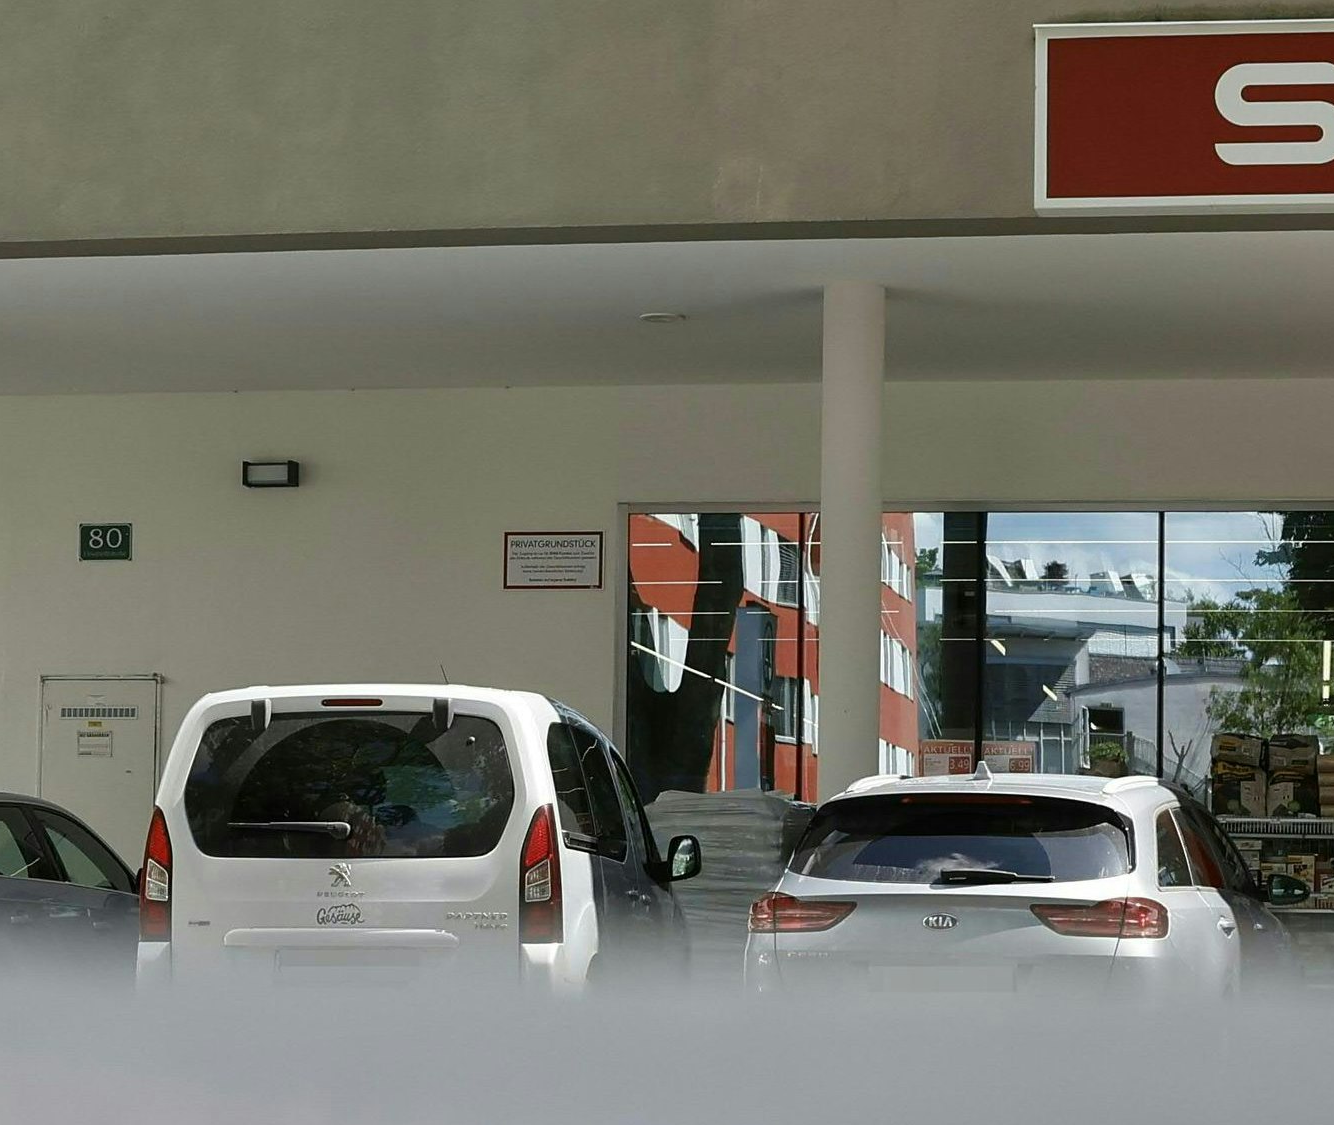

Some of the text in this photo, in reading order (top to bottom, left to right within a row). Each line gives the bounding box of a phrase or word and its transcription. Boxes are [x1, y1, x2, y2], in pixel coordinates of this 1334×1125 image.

[89, 528, 122, 549] 80
[510, 538, 596, 548] PRIVATGRUNDSTÜCK
[928, 916, 953, 927] KIA
